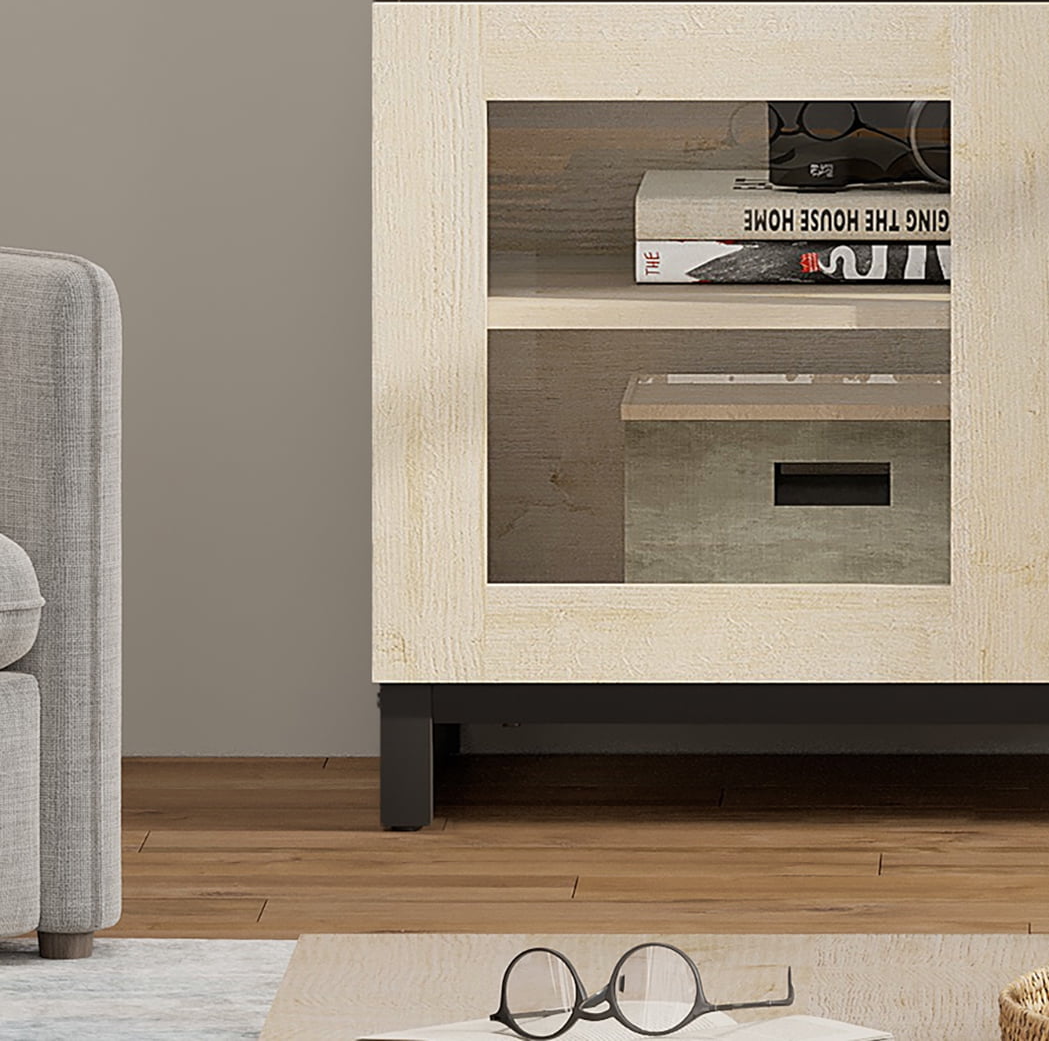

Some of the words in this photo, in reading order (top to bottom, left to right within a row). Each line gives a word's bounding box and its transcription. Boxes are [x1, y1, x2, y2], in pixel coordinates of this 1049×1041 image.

[744, 208, 795, 232] HOME
[800, 208, 859, 232] HOUSE
[865, 208, 901, 232] THE
[644, 250, 661, 277] THE
